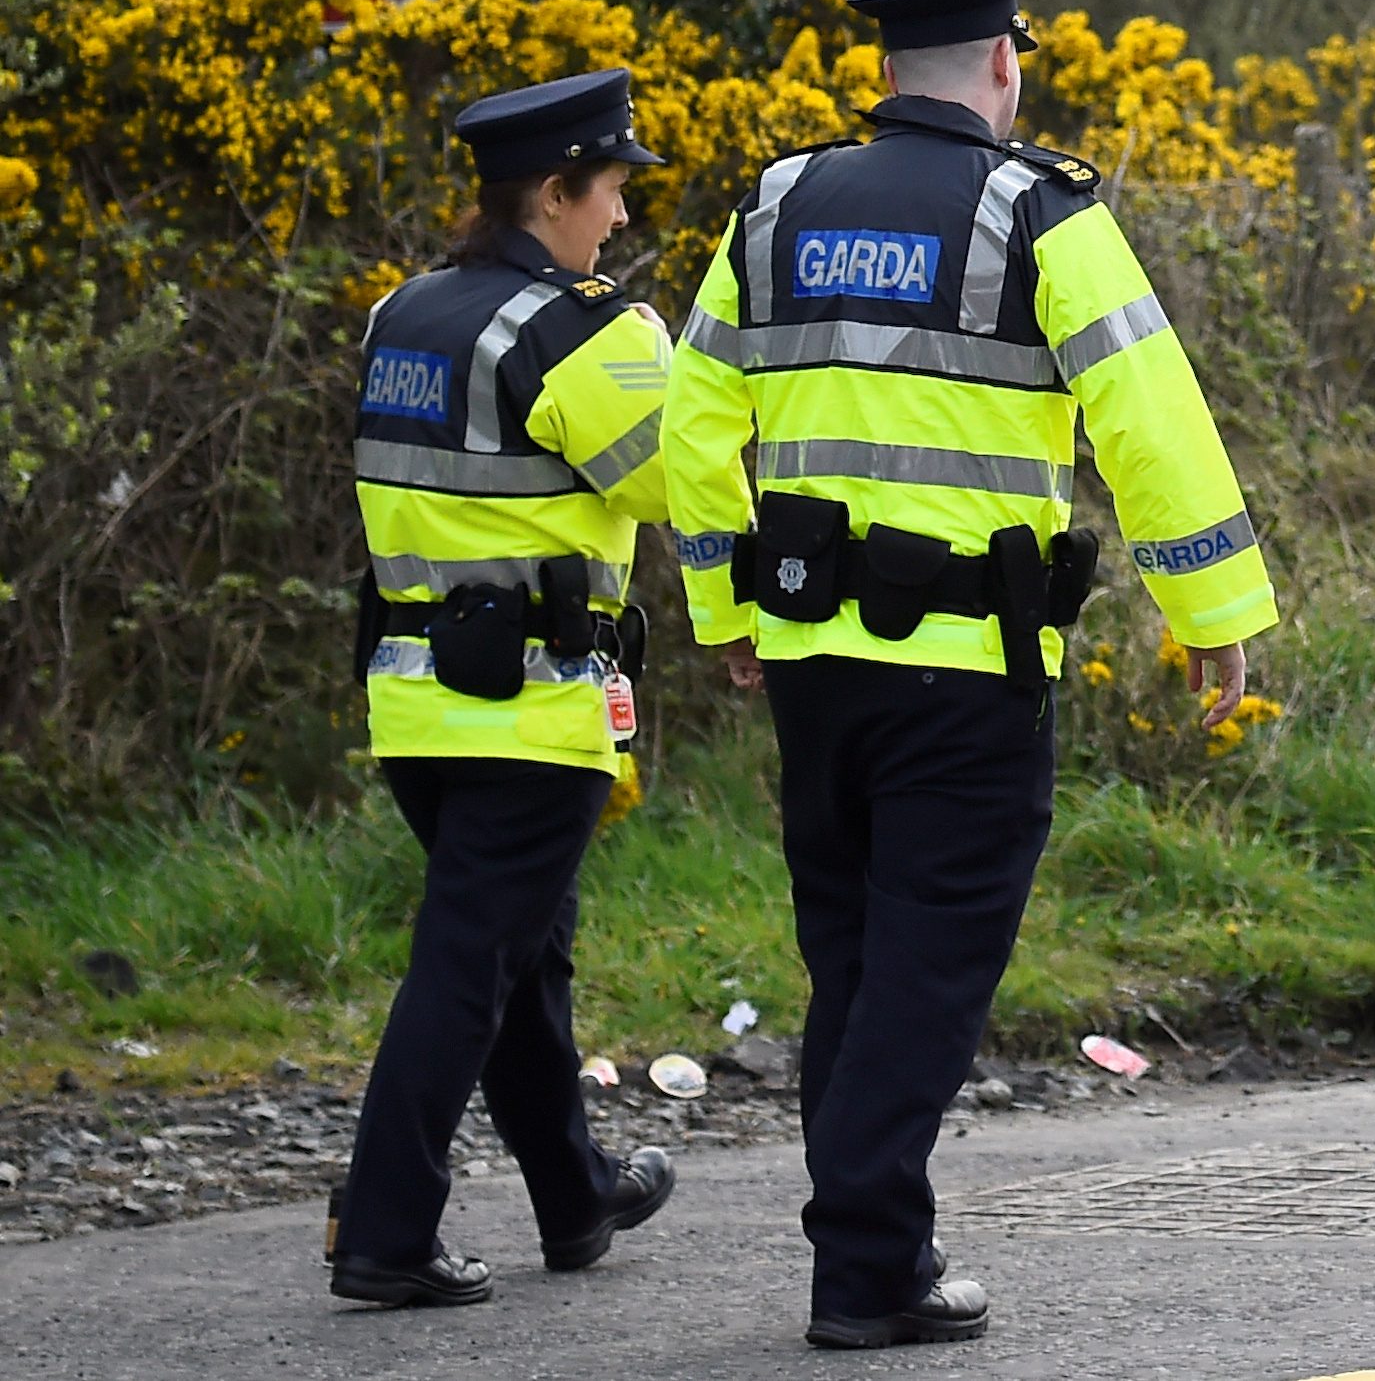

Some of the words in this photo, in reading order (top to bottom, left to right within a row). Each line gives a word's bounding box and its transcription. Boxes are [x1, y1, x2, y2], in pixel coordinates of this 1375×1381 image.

[797, 238, 928, 293] GARDA
[365, 356, 444, 408] GARDA
[1133, 530, 1234, 571] GARDA
